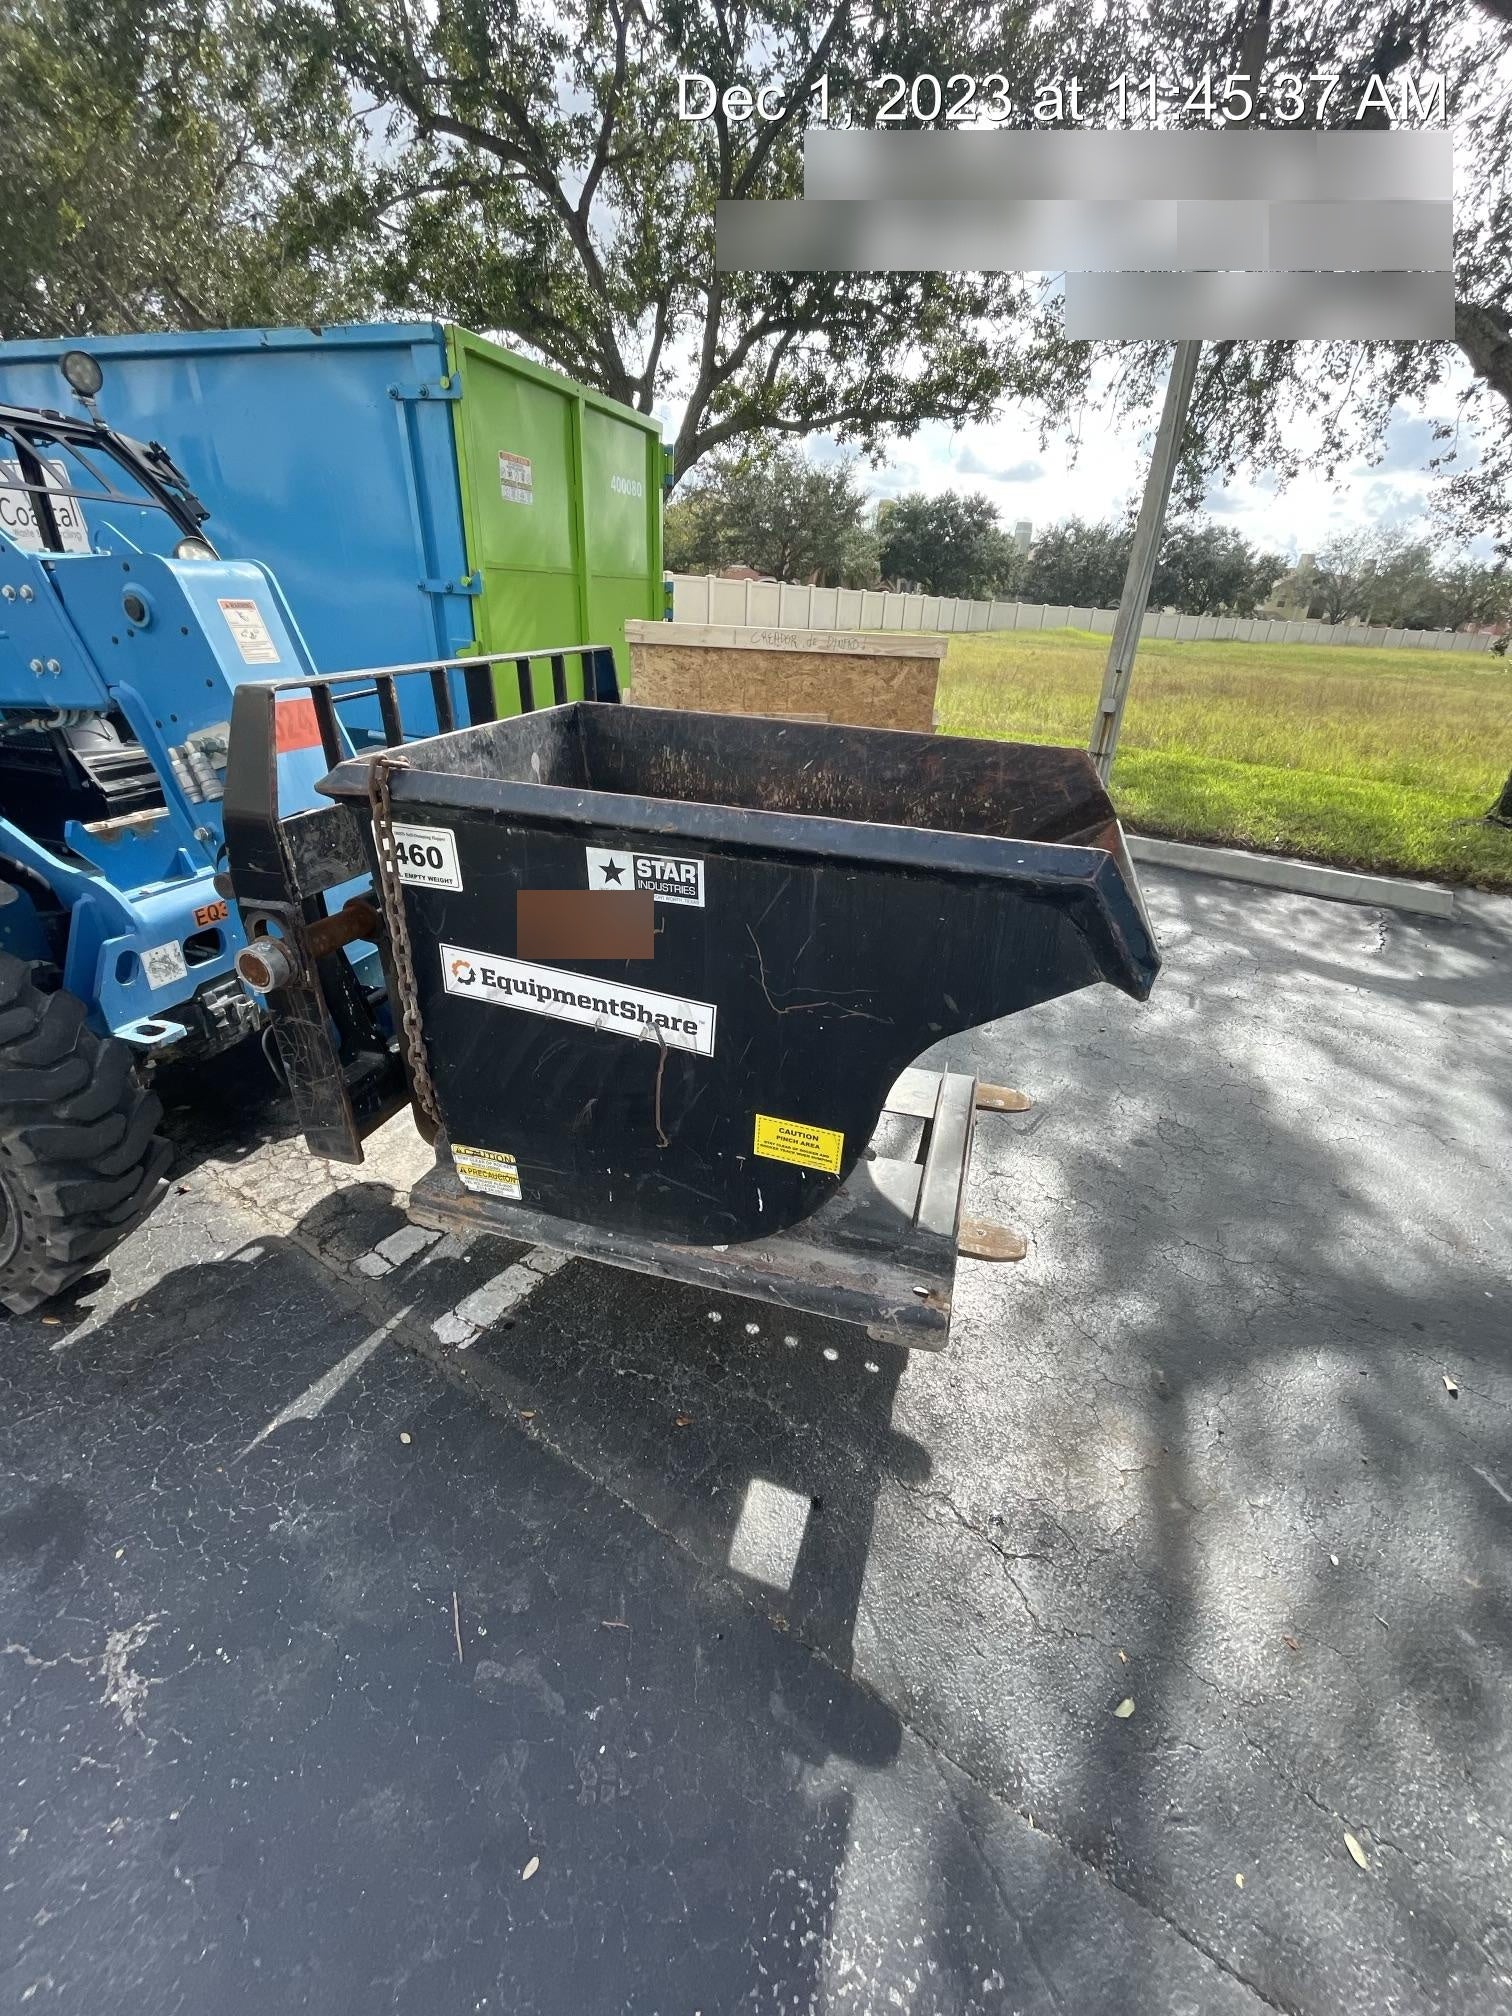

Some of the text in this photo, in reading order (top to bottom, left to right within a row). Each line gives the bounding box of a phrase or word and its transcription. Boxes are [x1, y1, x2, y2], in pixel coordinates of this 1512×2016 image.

[610, 473, 643, 498] 400080
[0, 497, 79, 527] Coaal
[395, 841, 444, 870] 460
[427, 875, 453, 884] WEIGHT
[636, 858, 697, 884] STAR
[637, 879, 696, 896] INDUSTRIES
[480, 966, 698, 1036] EquipmentShare
[776, 1135, 820, 1149] PINCH AREA
[778, 1127, 819, 1142] CAUTION
